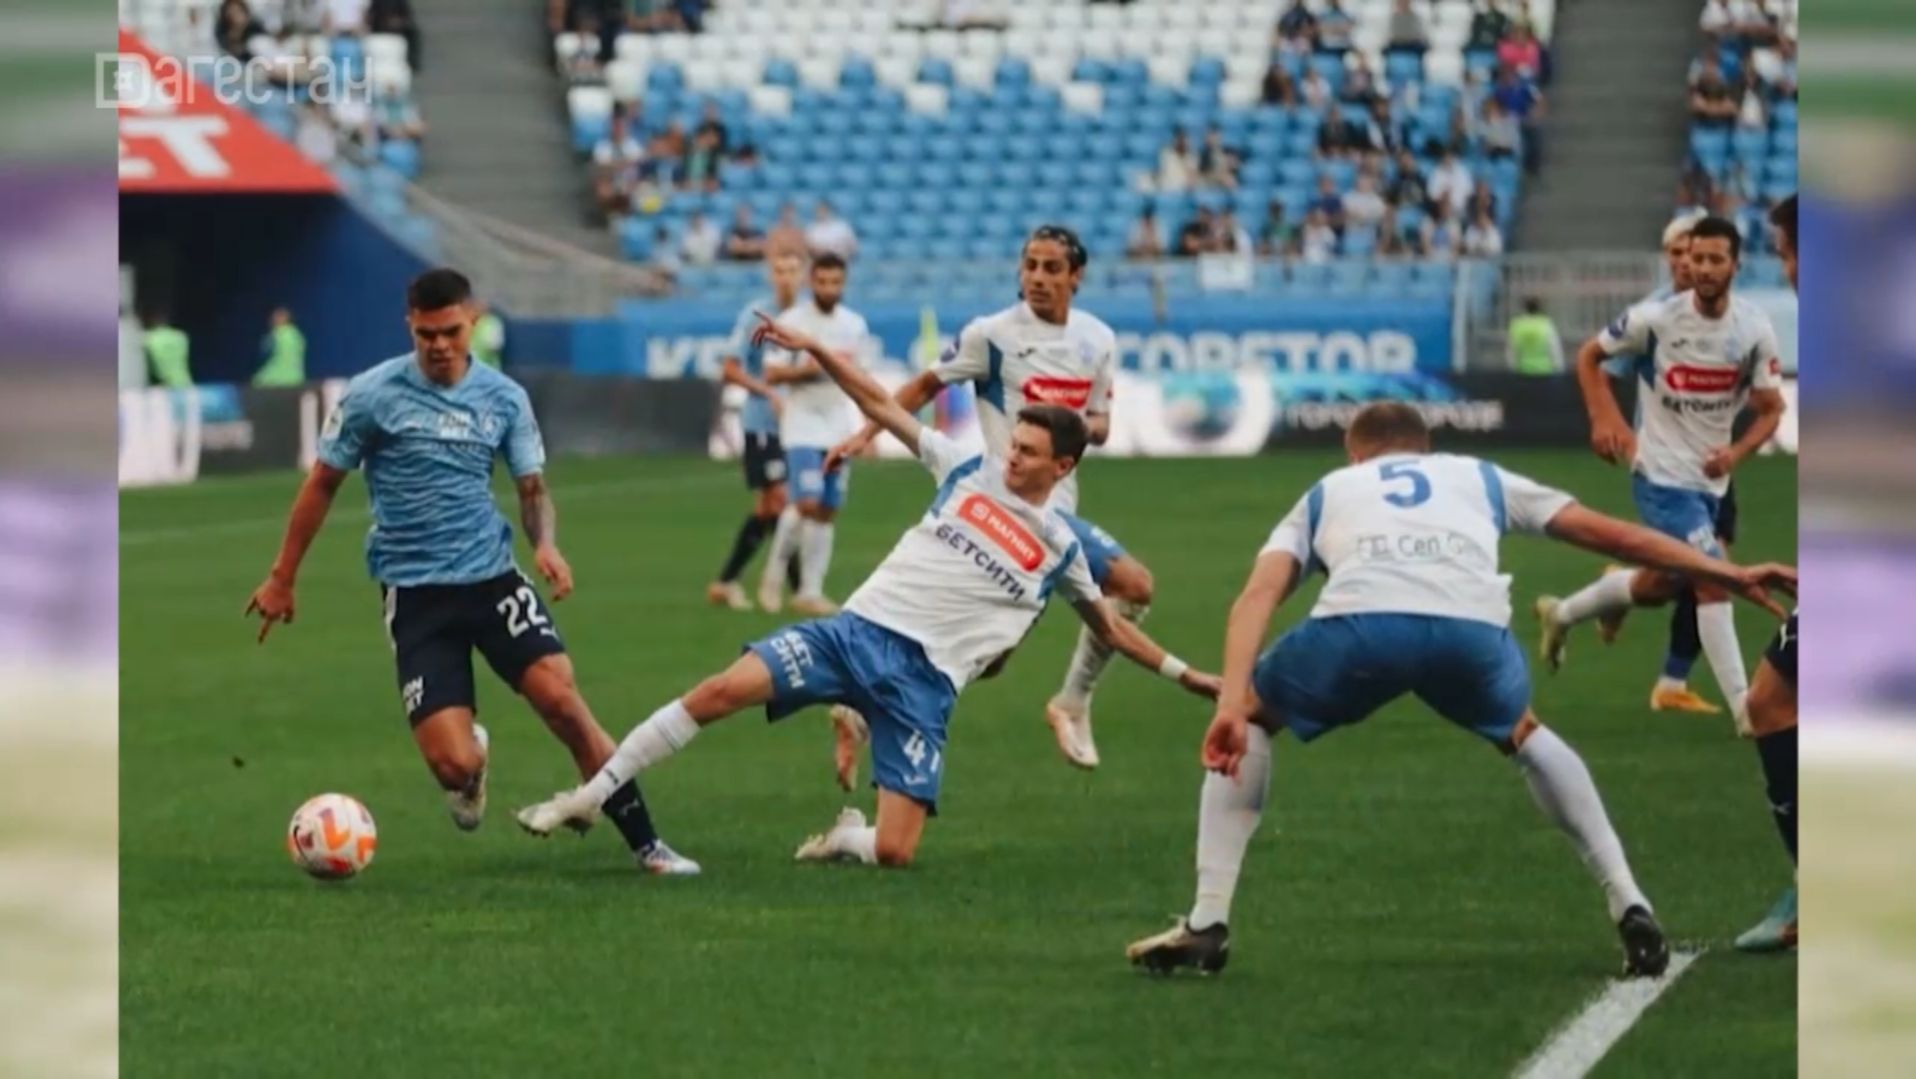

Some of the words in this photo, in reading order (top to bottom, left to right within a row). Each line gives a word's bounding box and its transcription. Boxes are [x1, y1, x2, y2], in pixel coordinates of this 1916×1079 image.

[1379, 460, 1432, 508] 5
[936, 524, 1025, 600] БЕТСИТИ
[496, 586, 548, 638] 22
